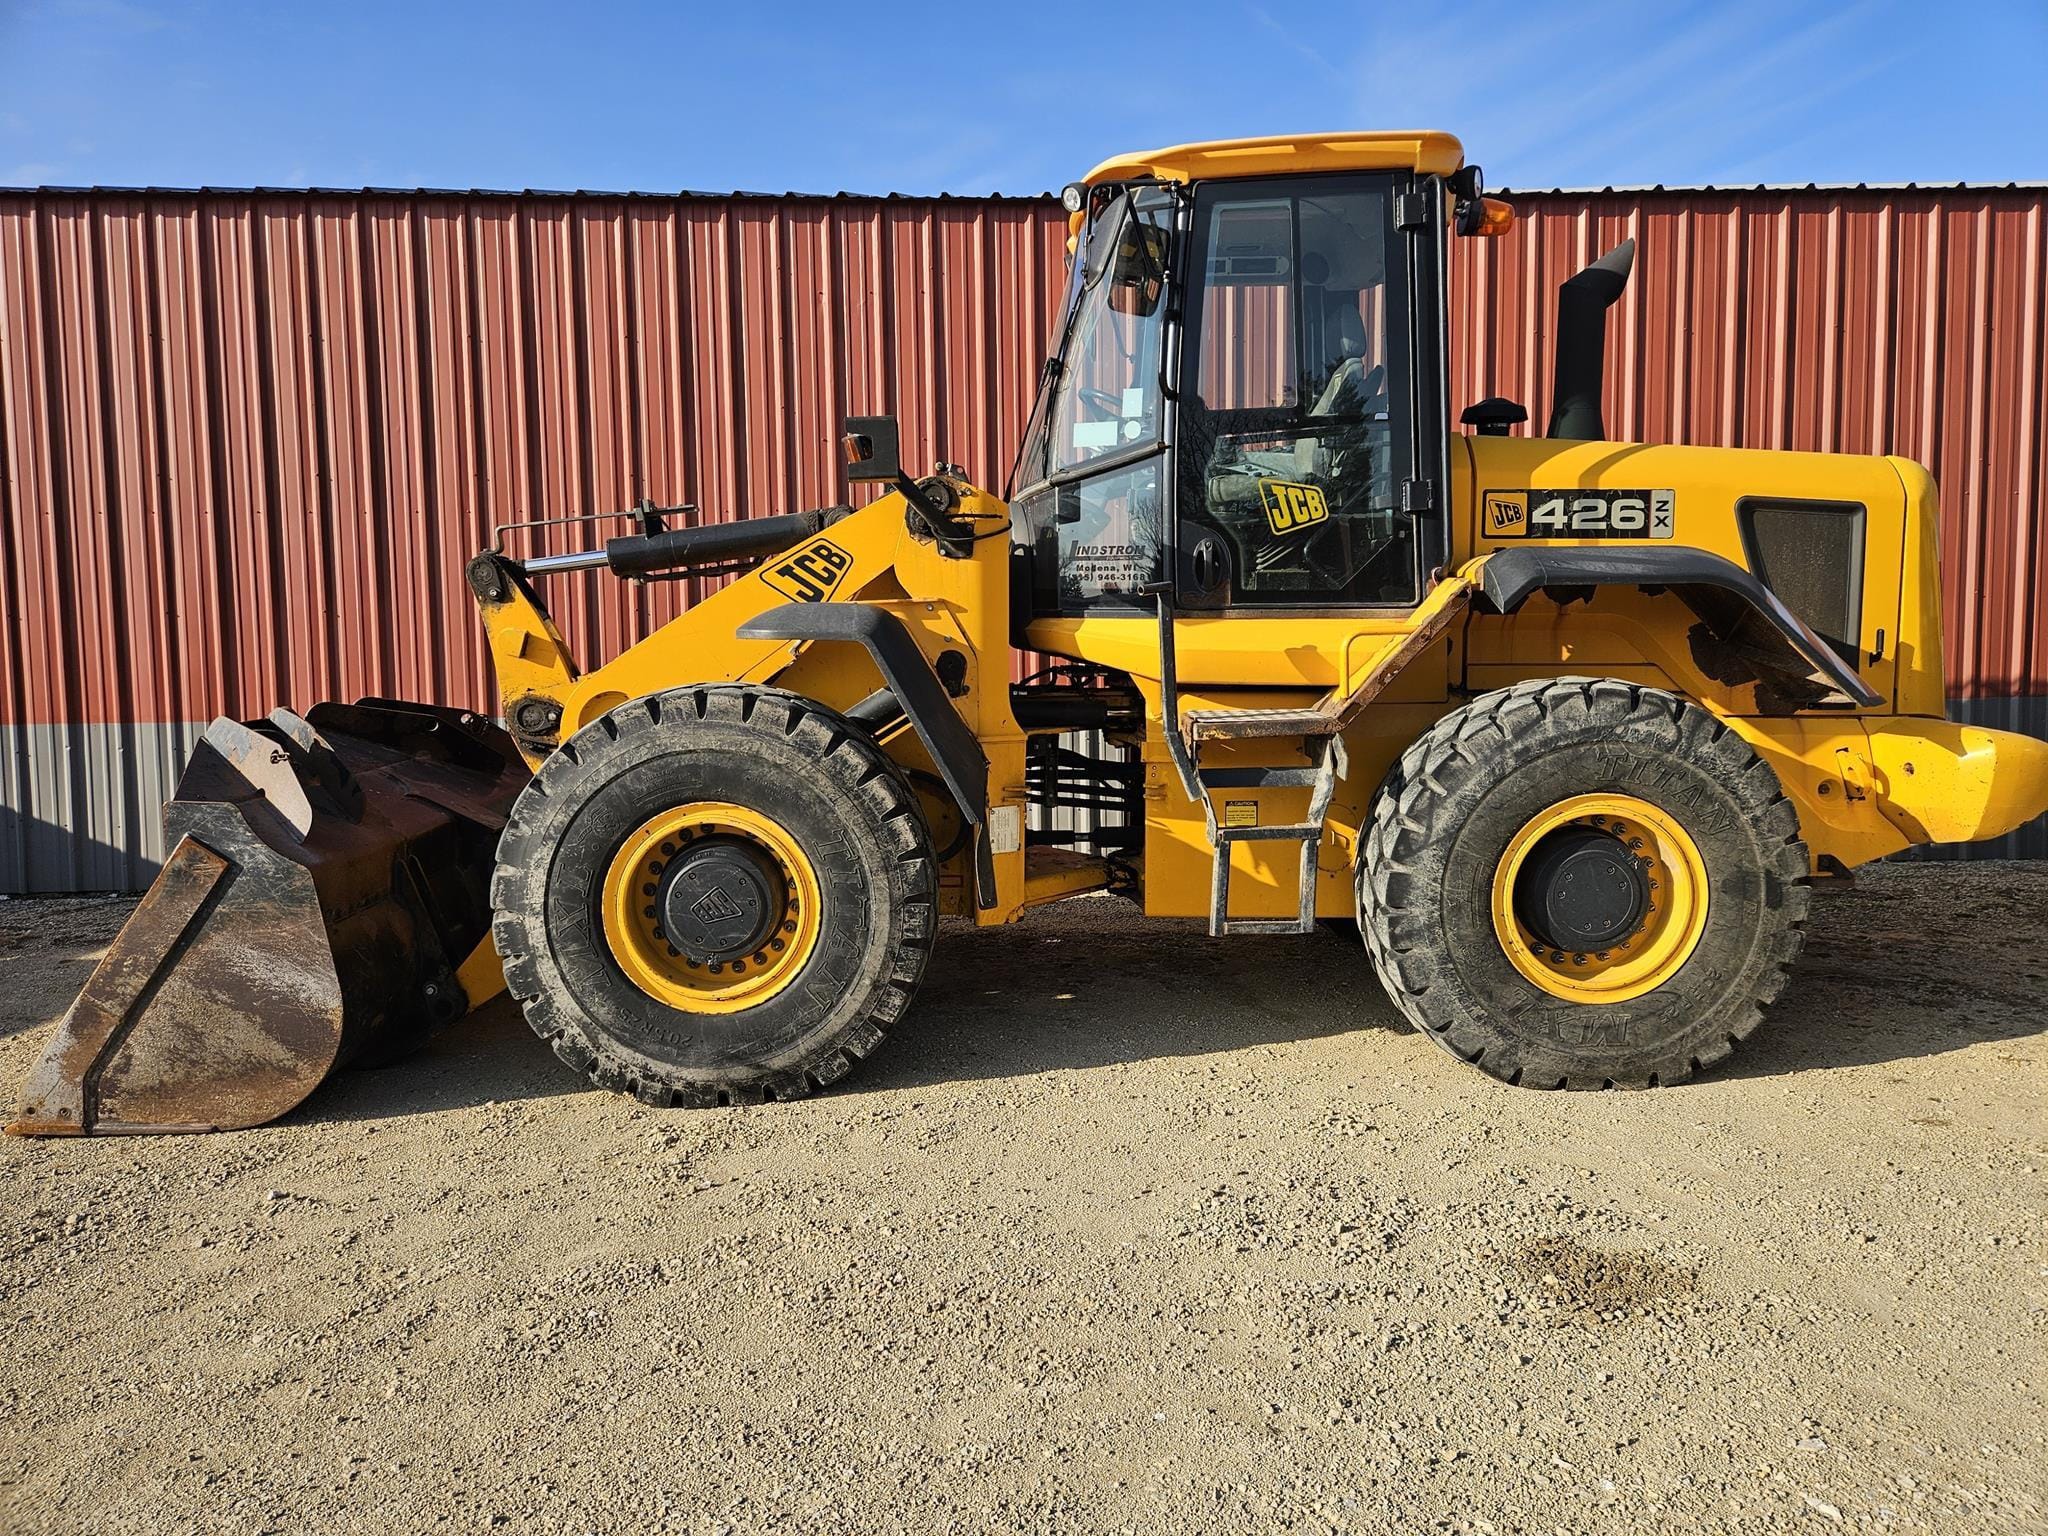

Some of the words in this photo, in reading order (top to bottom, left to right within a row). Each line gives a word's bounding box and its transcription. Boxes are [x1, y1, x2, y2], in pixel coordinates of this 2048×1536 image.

[1271, 484, 1324, 529] JCB
[1494, 501, 1522, 526] JCB
[1532, 498, 1646, 530] 426
[775, 544, 847, 603] JCB
[1098, 573, 1145, 581] 946-3168
[1594, 751, 1738, 835] TITAN
[806, 829, 869, 1014] TITAN
